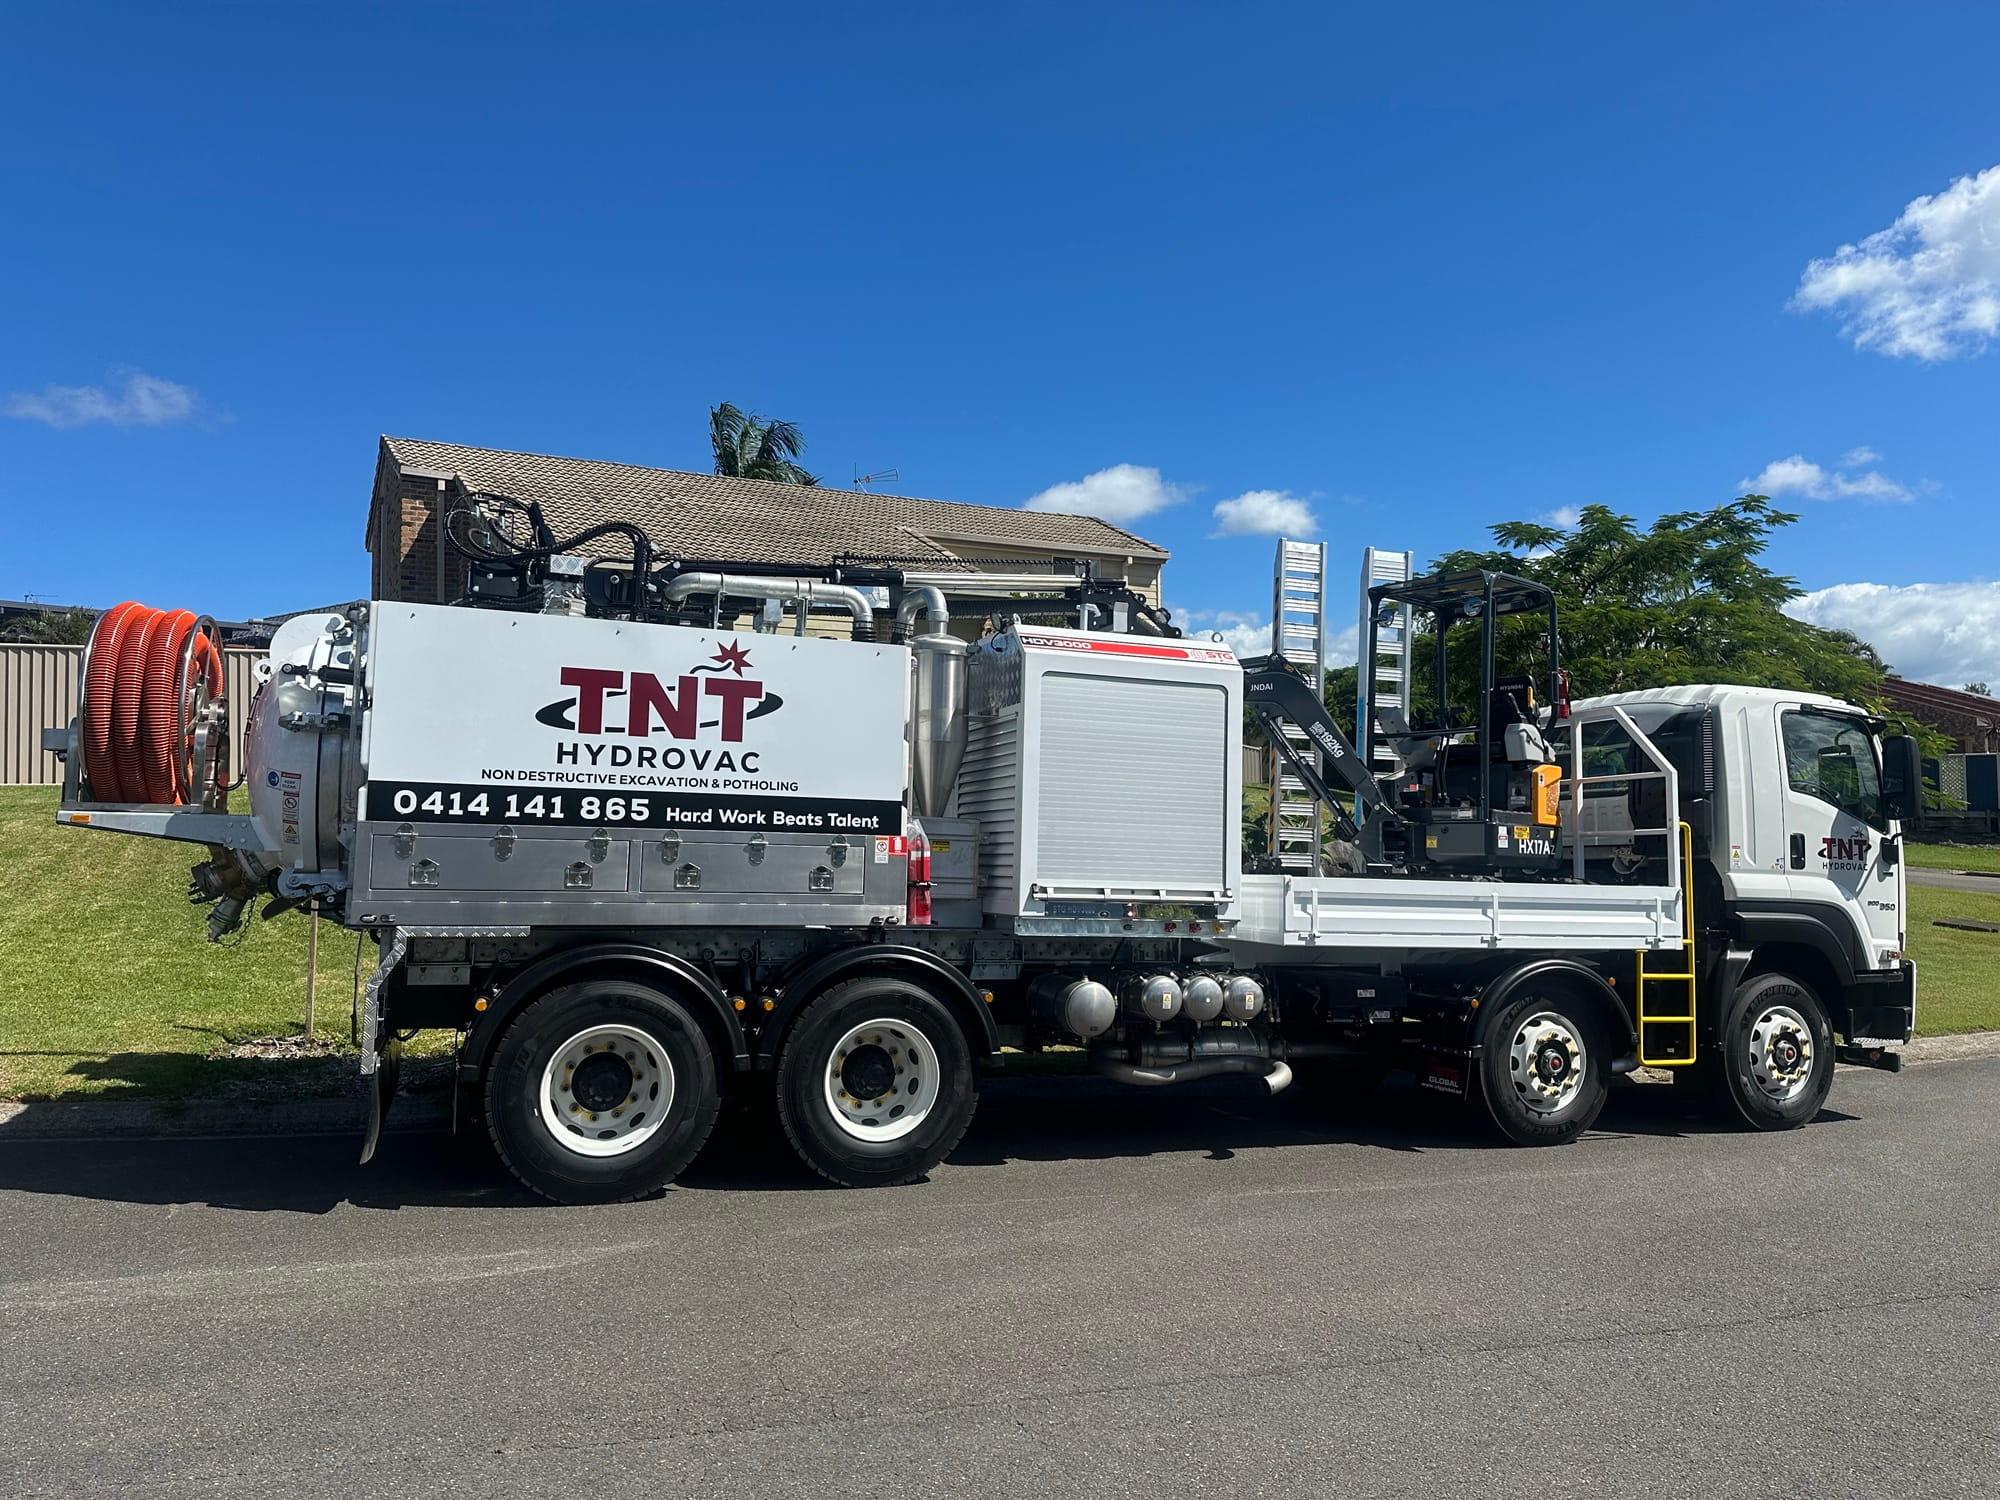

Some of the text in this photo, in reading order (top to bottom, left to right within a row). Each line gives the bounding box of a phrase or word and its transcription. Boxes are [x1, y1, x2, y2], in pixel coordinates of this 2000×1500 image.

[1021, 637, 1092, 649] HDV3000
[1206, 651, 1233, 660] STG
[560, 667, 763, 742] TNT
[1320, 731, 1345, 758] 192Kg
[557, 742, 760, 774] HYDROVAC
[481, 769, 799, 792] NON DESTRUCTIVE EXCAVATION & POTHOLING
[393, 789, 879, 829] 0414 141 865 Hard Work Beats Talent
[1822, 838, 1867, 861] TNT
[1822, 862, 1868, 871] HYDROVAC
[1428, 1075, 1459, 1088] GLOBAL
